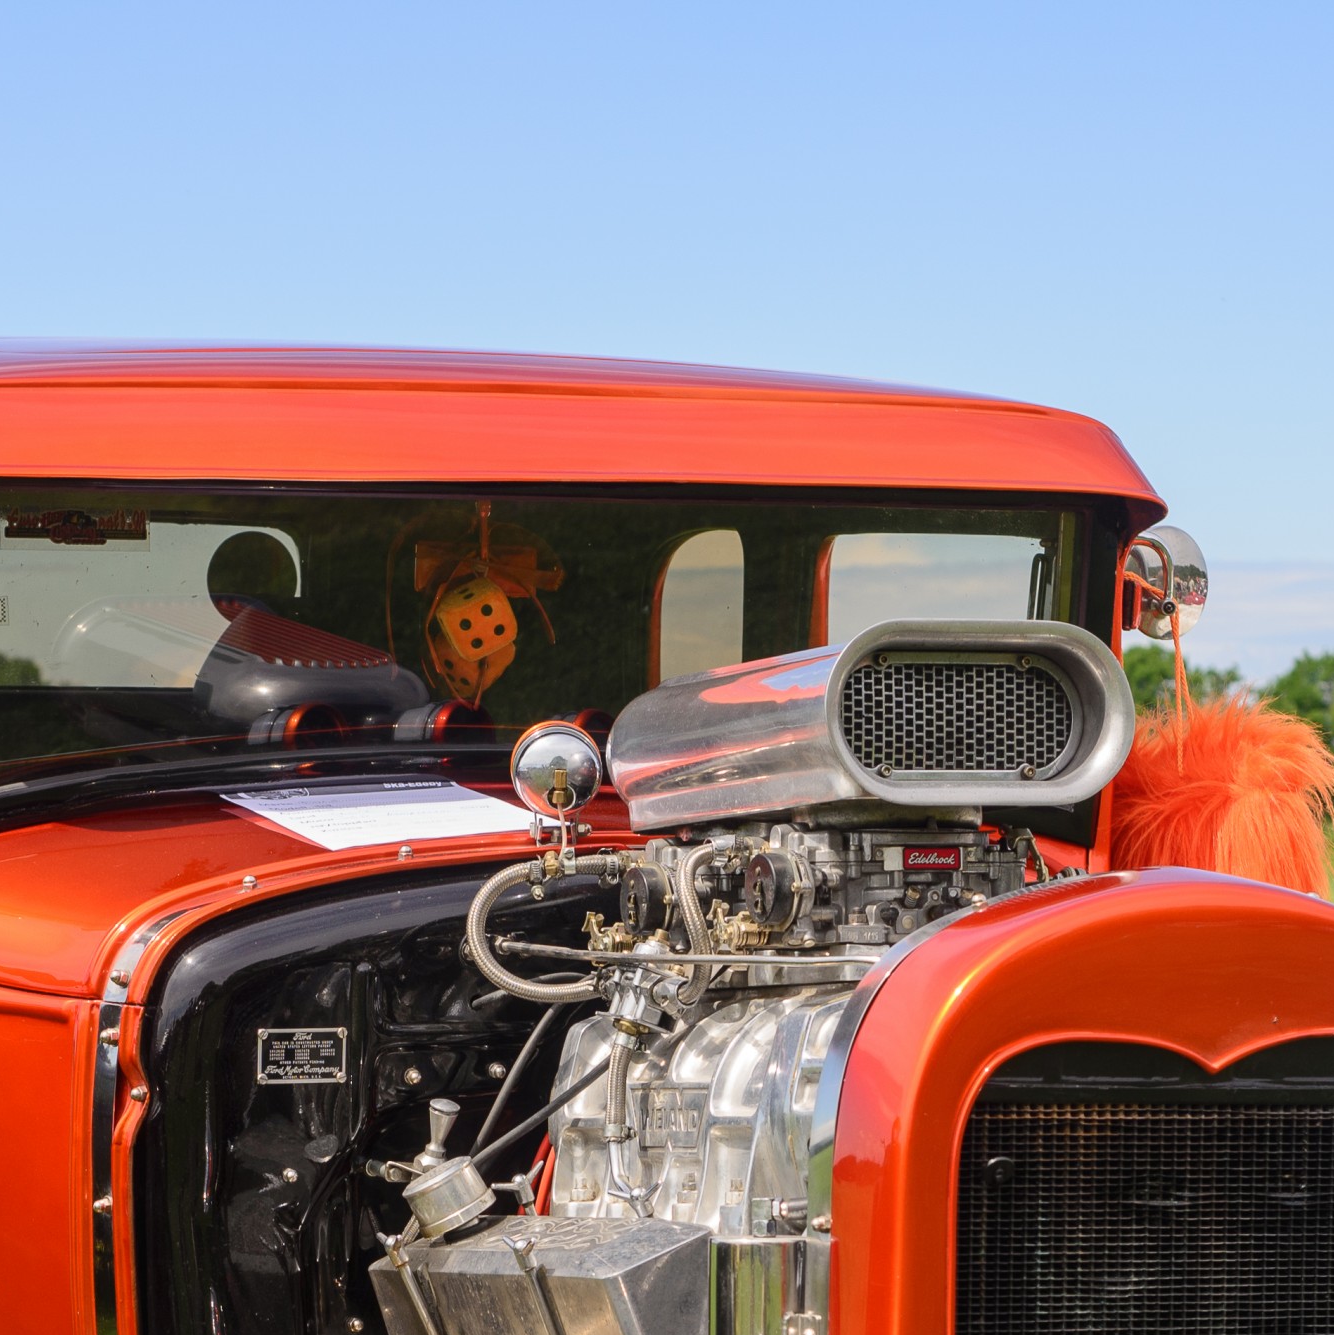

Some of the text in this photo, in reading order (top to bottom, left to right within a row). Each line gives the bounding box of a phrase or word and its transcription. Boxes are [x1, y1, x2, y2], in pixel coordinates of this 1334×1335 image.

[908, 852, 956, 865] Edelbrock
[293, 1032, 313, 1041] Ford
[264, 1064, 340, 1076] Ford Motor Company
[641, 1108, 698, 1132] WEIAND
